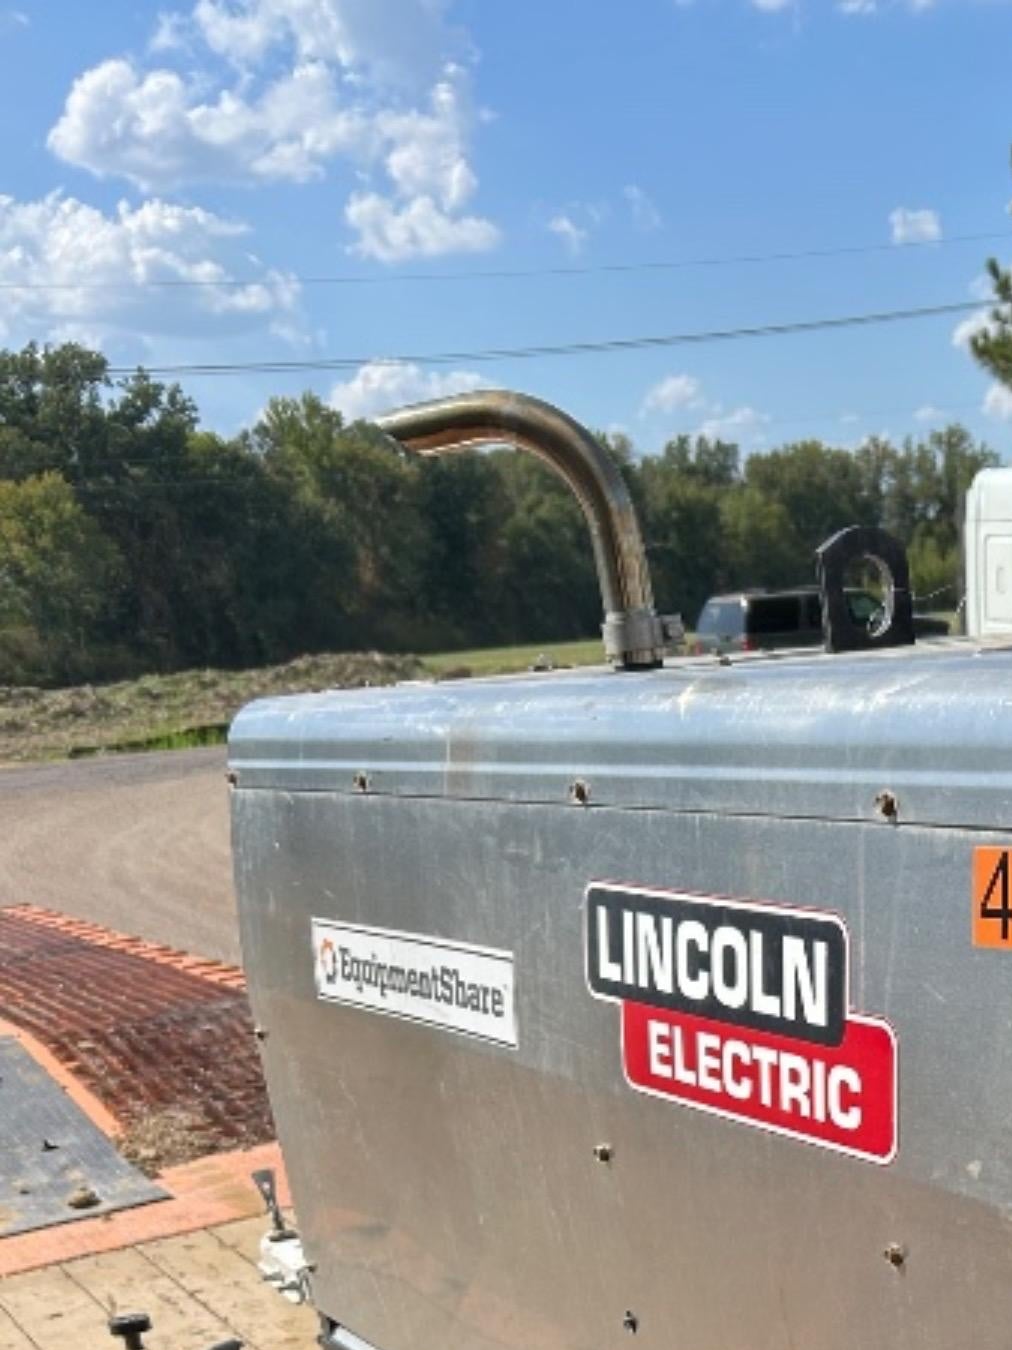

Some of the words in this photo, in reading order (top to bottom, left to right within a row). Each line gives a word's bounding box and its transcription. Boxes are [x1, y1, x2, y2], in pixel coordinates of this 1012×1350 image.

[338, 946, 505, 1018] EquipmentShare
[596, 904, 829, 1028] LINCOLN
[646, 1018, 862, 1131] ELECTRIC
